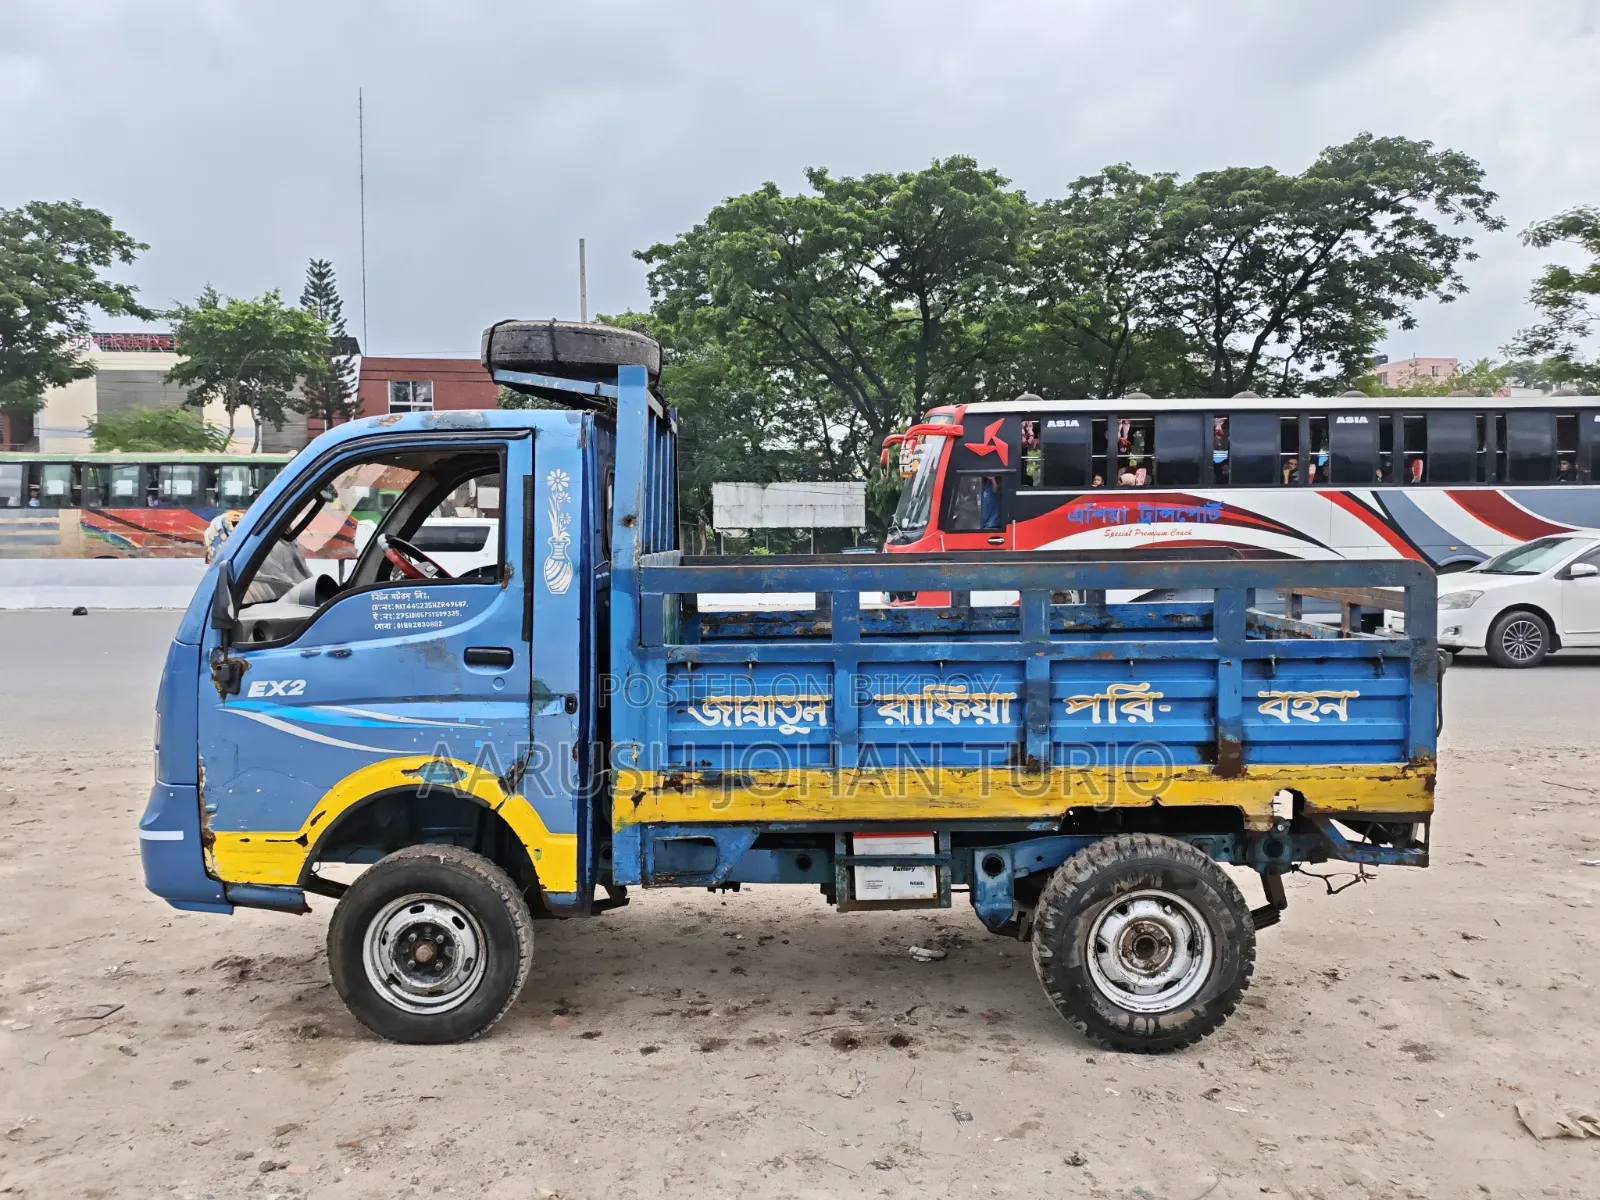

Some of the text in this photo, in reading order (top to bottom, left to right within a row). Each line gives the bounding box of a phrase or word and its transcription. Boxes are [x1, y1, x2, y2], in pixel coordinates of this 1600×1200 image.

[1046, 419, 1080, 428] ASIA
[1336, 416, 1369, 424] ASIA
[1067, 502, 1132, 525] এশিয়া
[1104, 527, 1193, 539] Special Premium Coach
[247, 679, 307, 698] EX2
[687, 693, 833, 736] জান্নাতুল
[873, 684, 1018, 726] রাফিয়া
[1258, 690, 1360, 724] বহন
